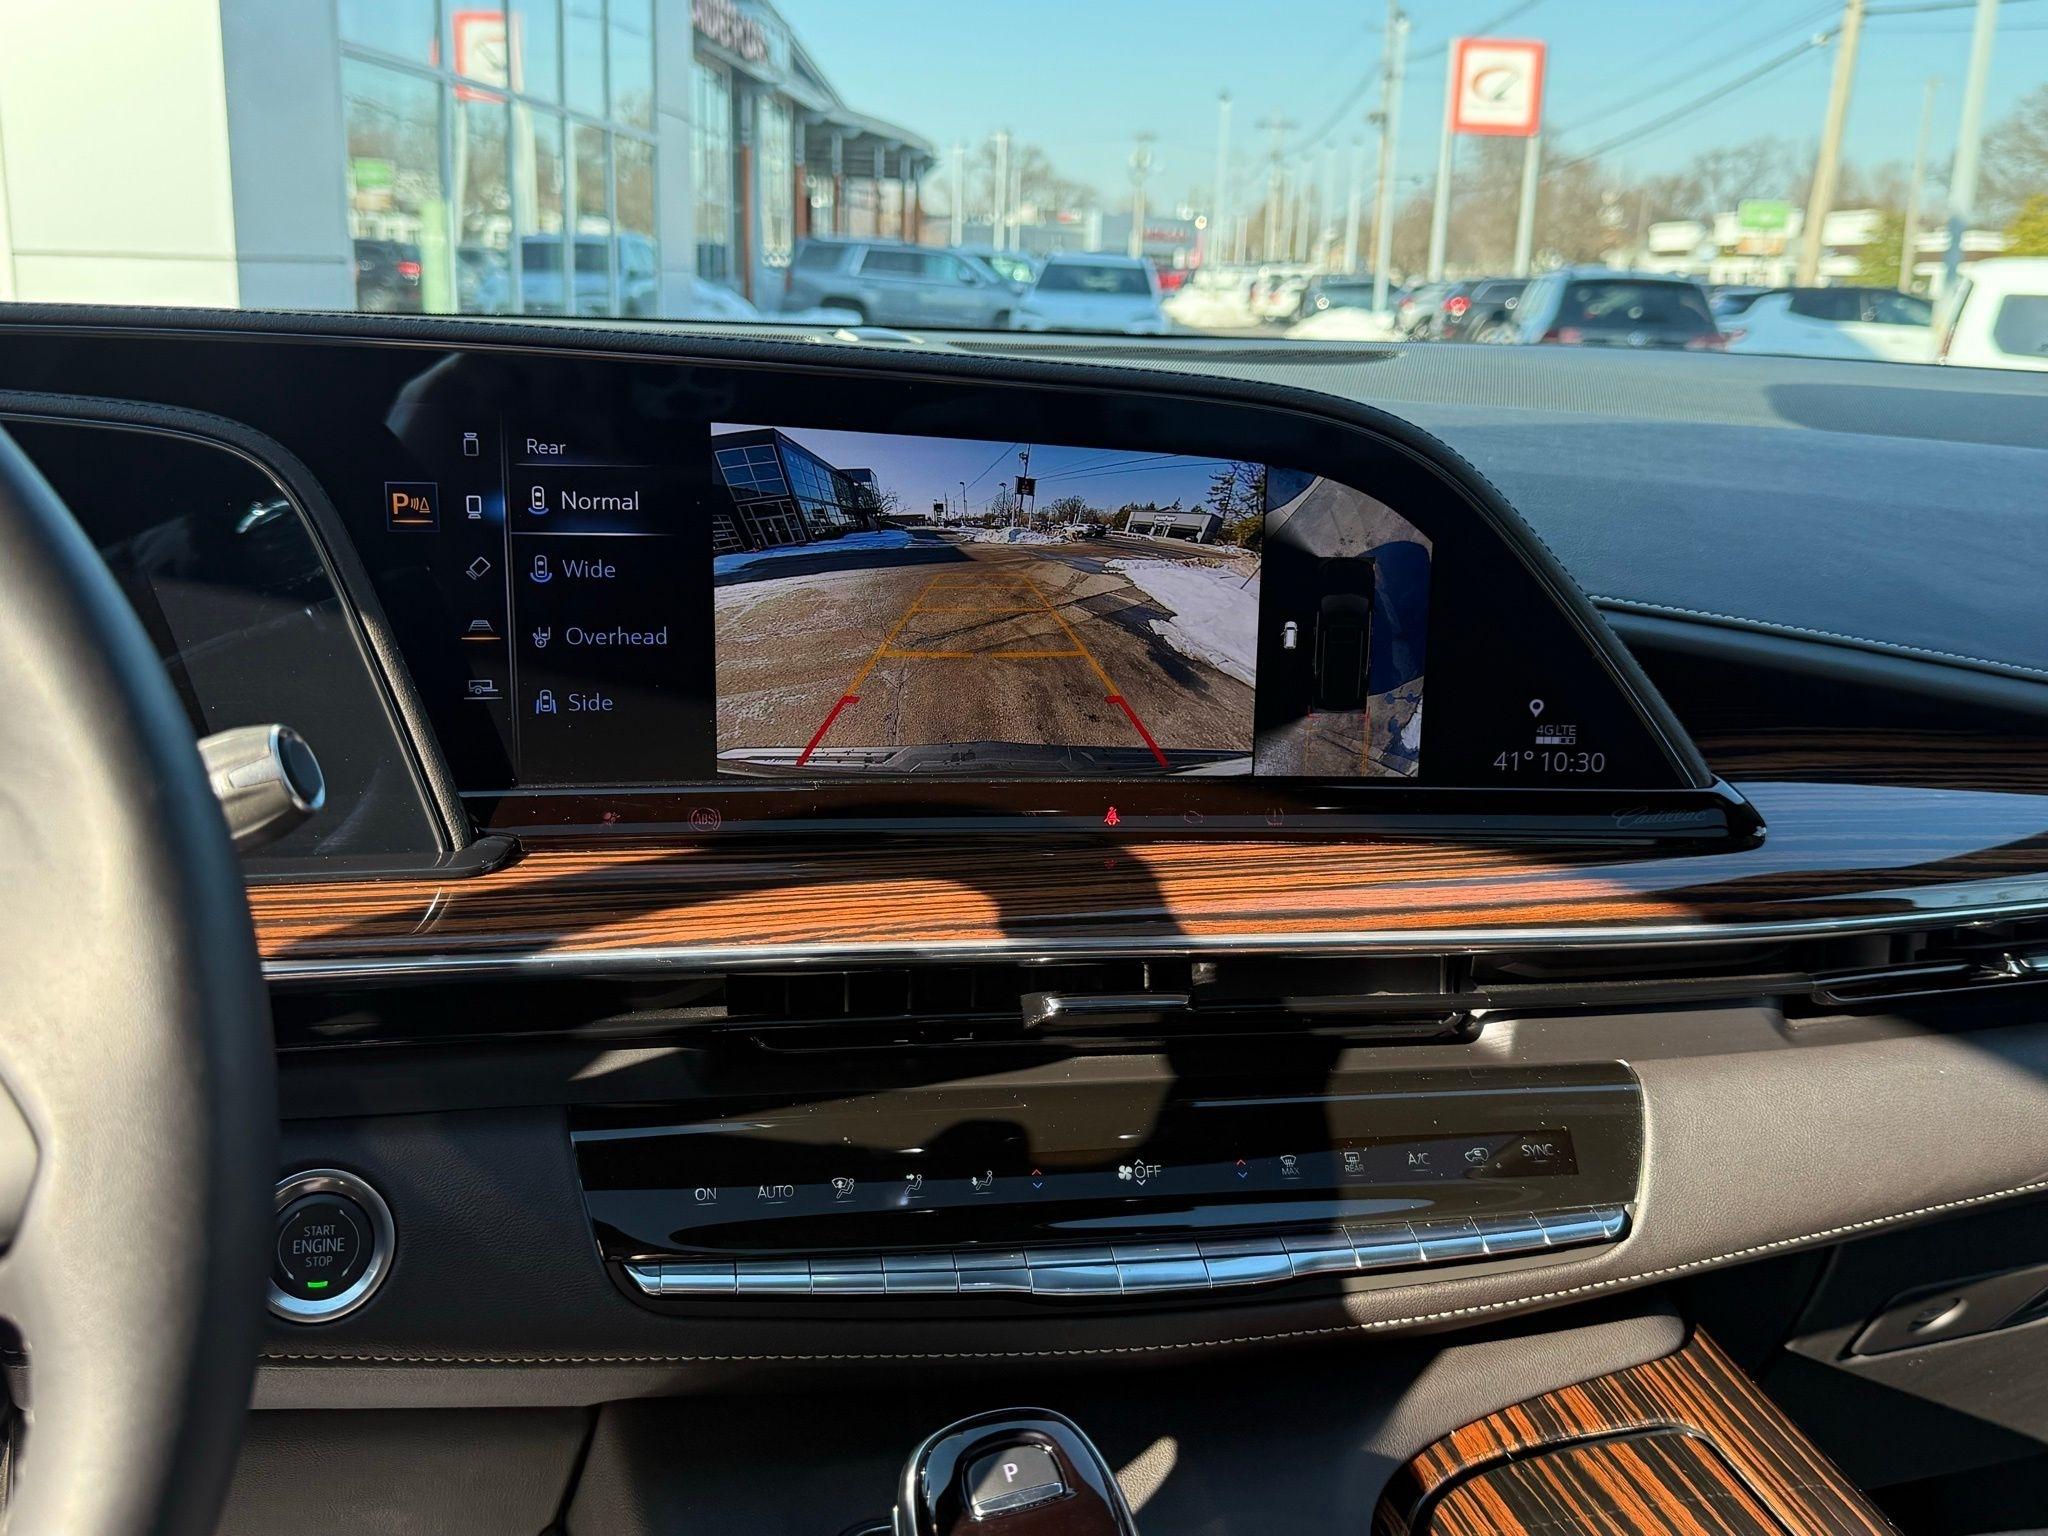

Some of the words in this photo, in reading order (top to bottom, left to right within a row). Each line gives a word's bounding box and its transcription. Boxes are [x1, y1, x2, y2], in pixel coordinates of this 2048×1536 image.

[526, 438, 567, 456] Rear
[392, 493, 410, 515] P
[560, 490, 640, 512] Normal
[562, 559, 617, 580] Wide
[565, 626, 669, 647] Overhead
[567, 693, 614, 713] Side
[1493, 750, 1534, 772] 41°
[1540, 751, 1606, 773] 10:30
[695, 813, 715, 825] ABS
[1521, 1143, 1555, 1158] SYNC
[1407, 1152, 1432, 1166] A/C
[1134, 1164, 1162, 1180] OFF
[1281, 1167, 1301, 1176] MAX
[1344, 1164, 1365, 1173] REAR
[694, 1187, 718, 1202] ON
[757, 1184, 795, 1199] AUTO
[303, 1224, 336, 1237] START
[293, 1237, 345, 1254] ENGINE
[305, 1255, 334, 1268] STOP
[1002, 1462, 1018, 1483] P
